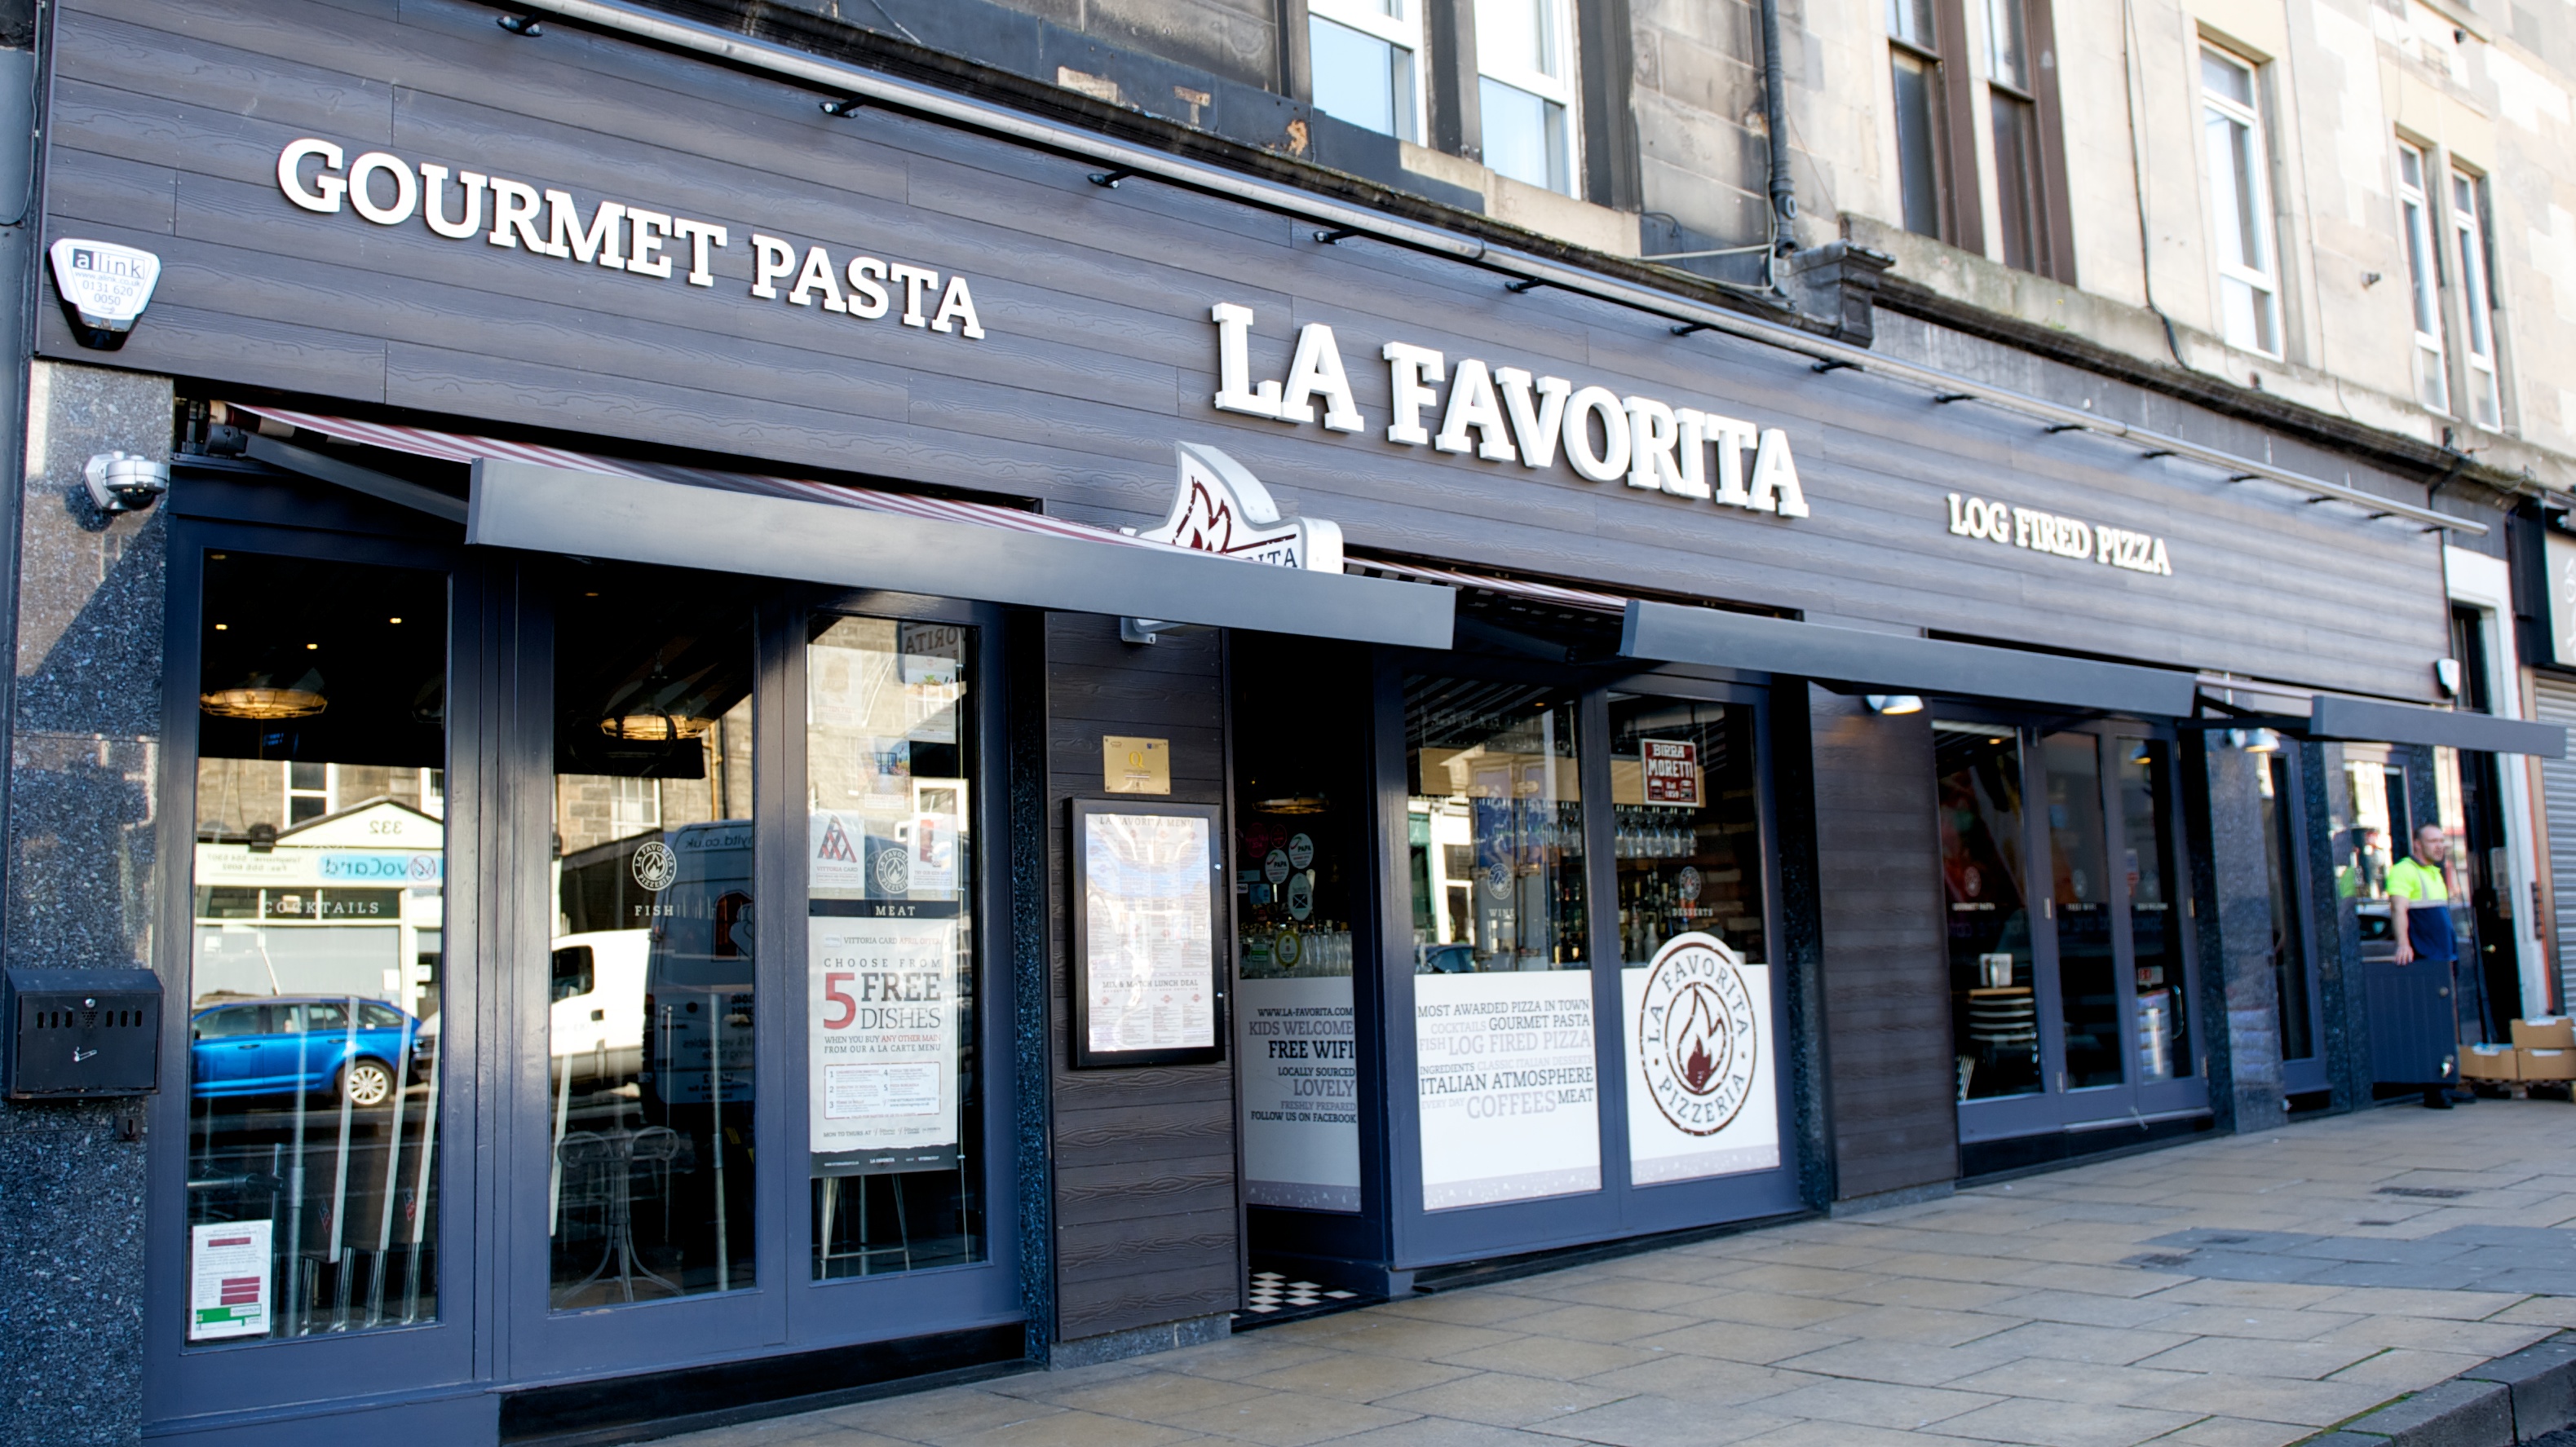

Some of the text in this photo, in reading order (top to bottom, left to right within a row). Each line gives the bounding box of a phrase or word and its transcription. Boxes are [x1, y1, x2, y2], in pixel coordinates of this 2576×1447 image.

[276, 137, 985, 339] GOURMET PASTA
[76, 253, 141, 279] alink
[82, 280, 133, 297] 0131 620
[94, 293, 121, 306] 0050
[1211, 302, 1809, 518] LA FAVORITA
[1946, 492, 2172, 576] LOG FIRED PIZZA
[1651, 743, 1686, 759] BIRRA
[1647, 759, 1694, 779] MORETTI
[263, 901, 380, 915] COCKTAILS
[634, 905, 674, 916] FISH
[875, 905, 916, 917] MEAT
[843, 937, 877, 945] VITTORIA
[878, 937, 897, 945] CARD
[824, 958, 941, 968] CHOOSE FROM
[823, 973, 941, 1030] 5 FREE
[1647, 954, 1749, 1043] LA FAVORITA
[1257, 1007, 1353, 1017] WWW.LA-FAVORITA.COM
[1417, 999, 1590, 1017] MOST AWARDED PIZZA IN TOWN
[860, 1007, 941, 1030] DISHES
[1430, 1013, 1591, 1035] COCKTAILS GOURMET PASTA
[1248, 1020, 1354, 1036] KIDS WELCOME
[824, 1034, 941, 1044] WHEN YOU BUY ANY OTHER MAIN
[824, 1045, 846, 1053] FROM
[850, 1045, 867, 1053] OUR
[890, 1044, 916, 1052] CARTE
[918, 1043, 941, 1052] MENU
[1419, 1030, 1593, 1056] FISH LOG FIRED PIZZA
[1268, 1040, 1354, 1059] FREE WIFI
[1278, 1067, 1355, 1077] LOCALLY SOURCED
[1420, 1054, 1593, 1075] INGREDIENTS CLASSIC ITALIAN DESSERTS
[1293, 1079, 1355, 1097] LOVELY
[1421, 1066, 1593, 1096] ITALIAN ATMOSPHERE
[1280, 1101, 1356, 1112] FRESHLY PREPARED
[1421, 1087, 1594, 1119] EVERY DAY COFFEES MEAT
[1658, 1073, 1746, 1124] PIZZERIA
[1251, 1111, 1357, 1123] FOLLOW US ON FACEBOOK
